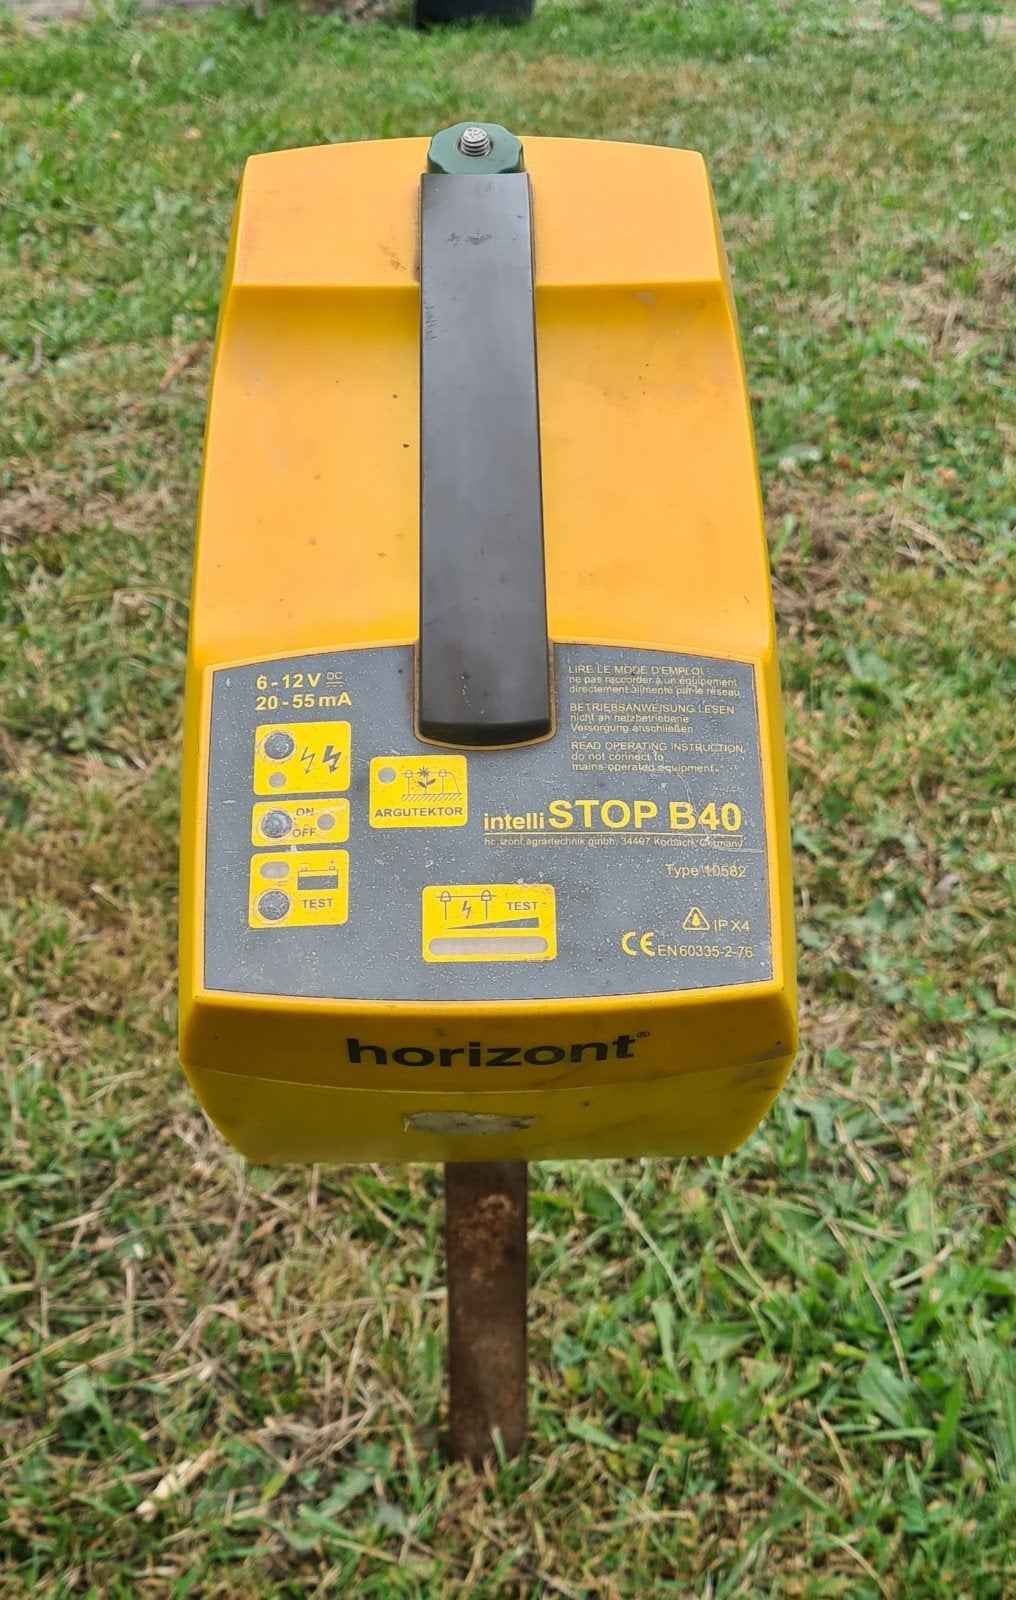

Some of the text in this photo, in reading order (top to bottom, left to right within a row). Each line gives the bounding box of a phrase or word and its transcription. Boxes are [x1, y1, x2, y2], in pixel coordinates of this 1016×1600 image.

[568, 665, 704, 676] LIRE LE MODE D'EMPLOI
[584, 676, 602, 684] pas
[605, 676, 652, 684] raccorder
[569, 684, 629, 694] directement
[676, 687, 691, 696] par
[695, 686, 704, 695] le
[570, 702, 735, 714] BETRIEBSANWEISUNG LESEN
[570, 713, 595, 722] nicht
[614, 714, 689, 723] netzbetriebene
[570, 722, 694, 734] Versorgung anschließen
[572, 741, 601, 750] READ
[604, 742, 667, 751] OPERATING
[572, 751, 664, 761] do not connect to
[572, 762, 604, 772] mains
[608, 762, 654, 772] operated
[296, 808, 314, 816] ON
[374, 806, 463, 818] ARGUTEKTOR
[484, 800, 742, 832] intelli STOP B40
[292, 828, 316, 838] OFF
[526, 838, 586, 847] agrartechnik
[665, 863, 746, 878] Type 10582
[302, 898, 334, 908] TEST
[506, 901, 538, 910] TEST
